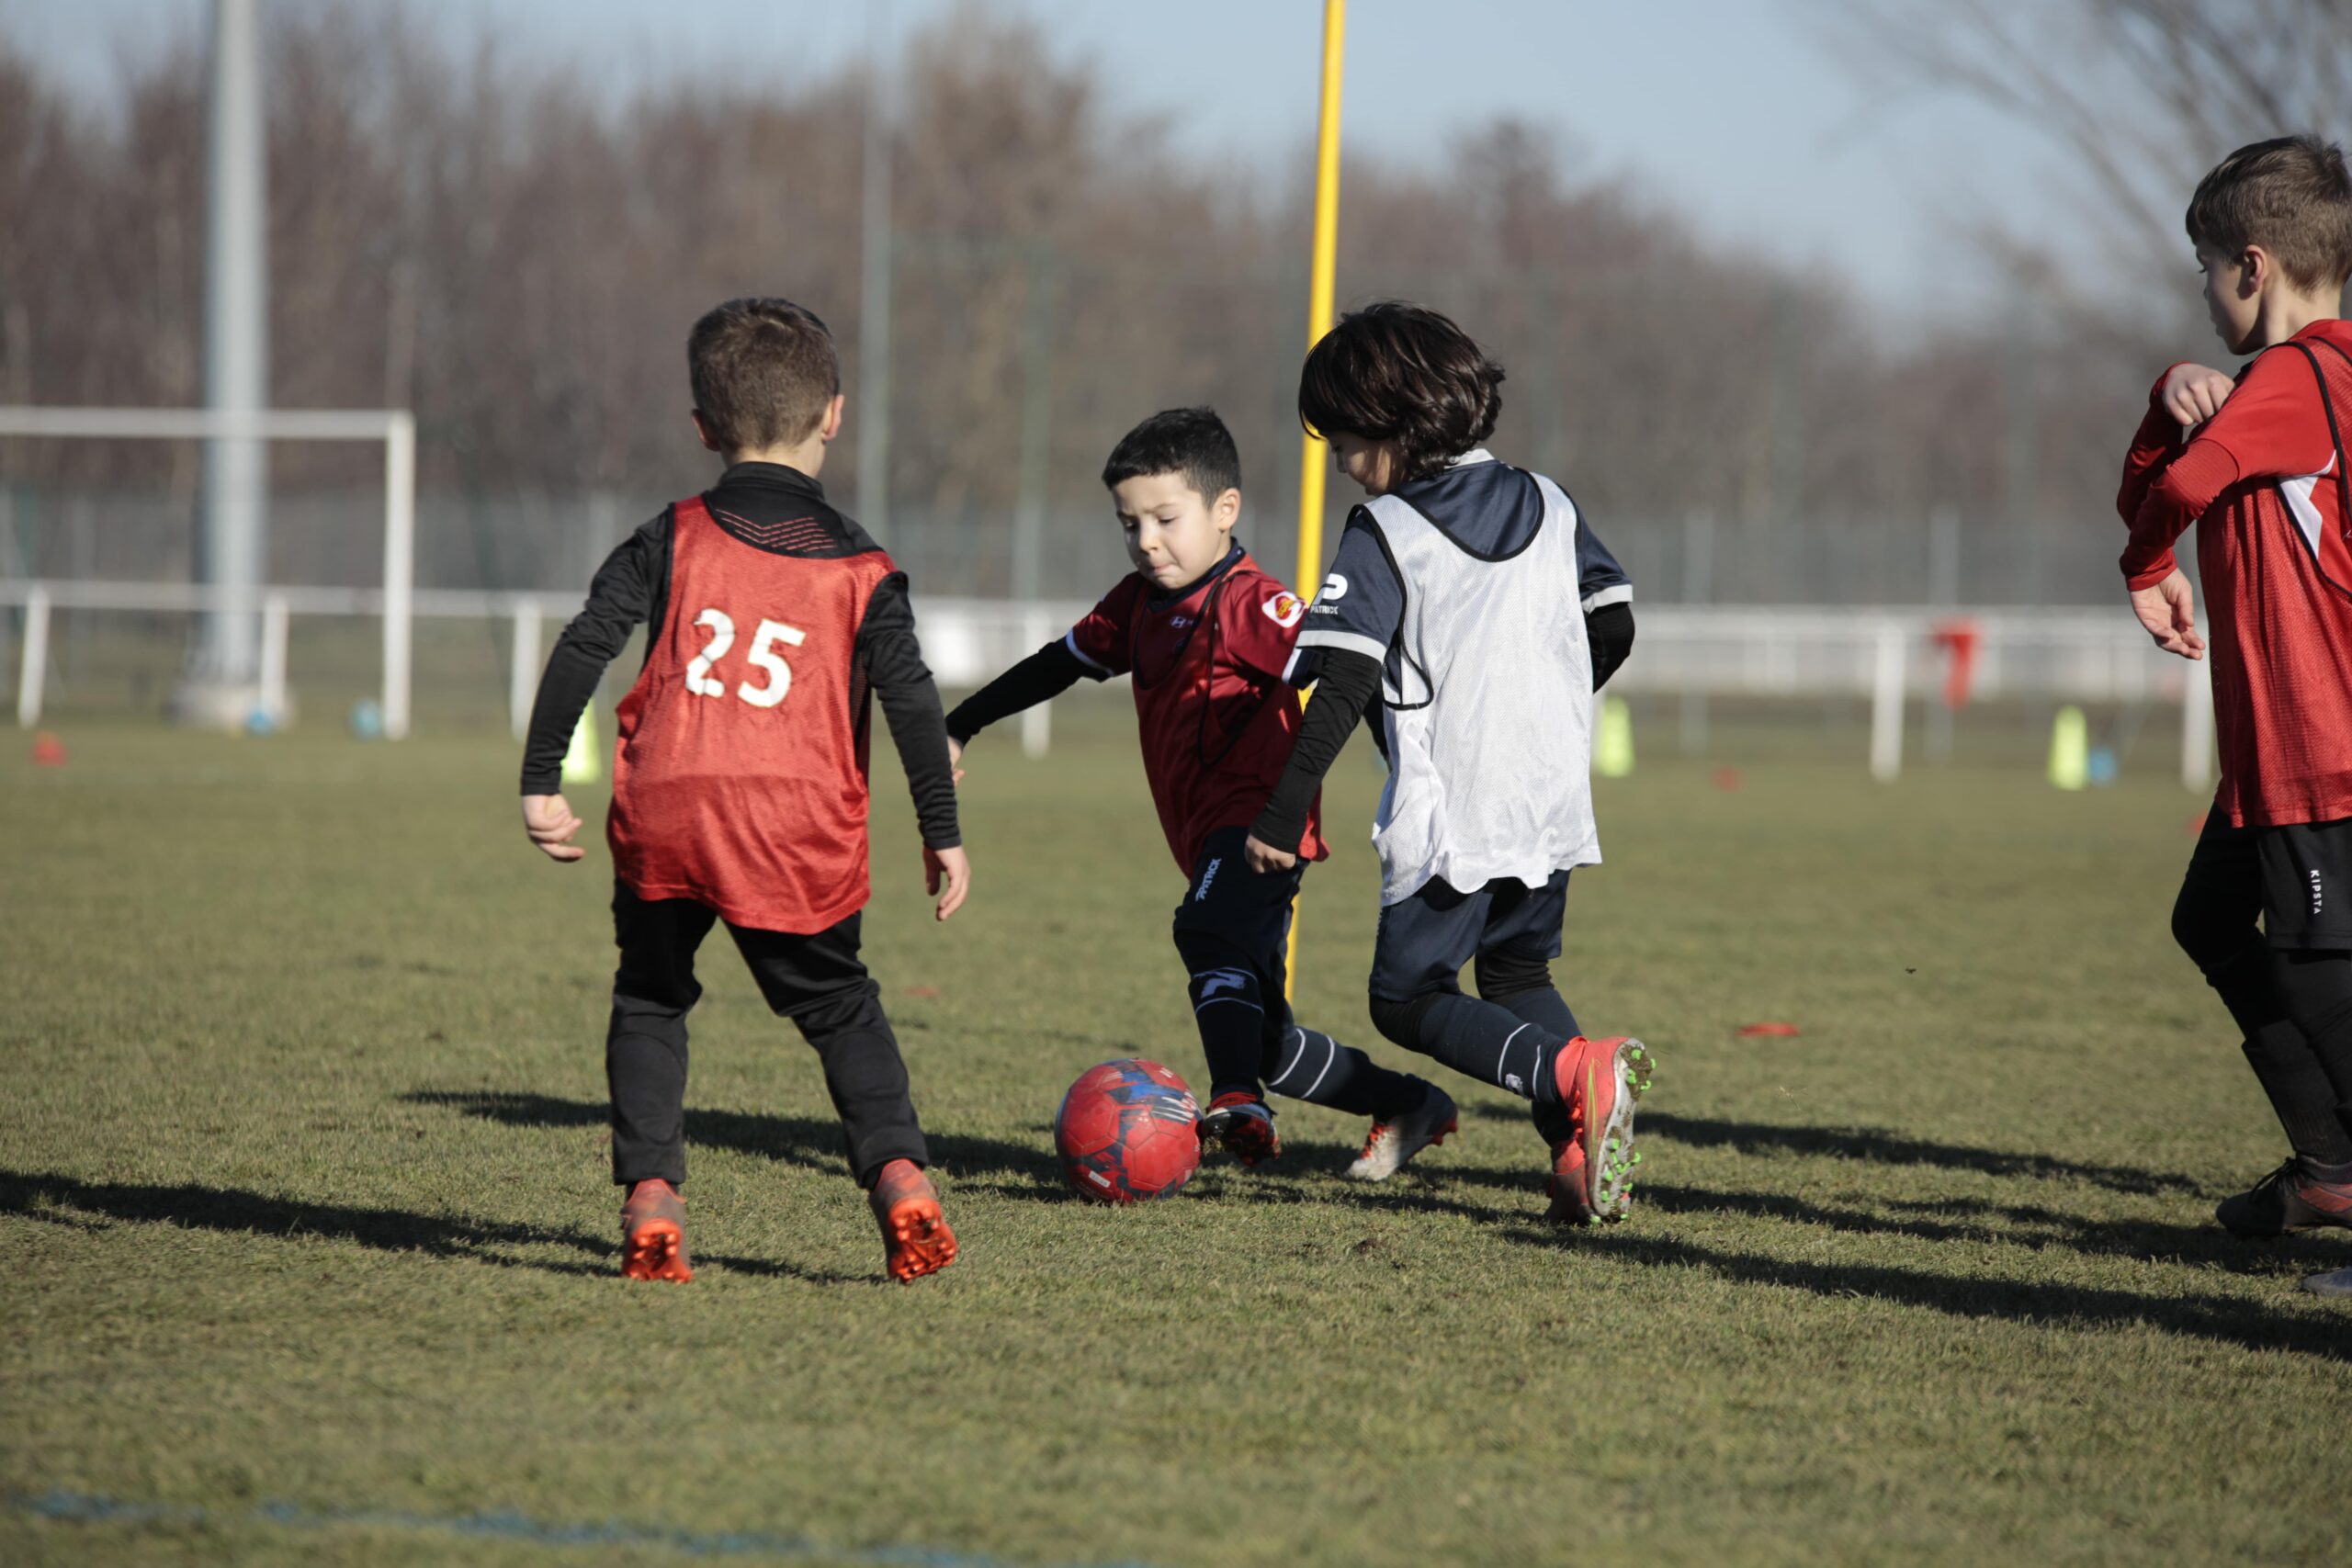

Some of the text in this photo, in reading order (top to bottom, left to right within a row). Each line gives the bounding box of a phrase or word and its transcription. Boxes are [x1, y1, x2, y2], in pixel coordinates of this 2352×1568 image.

[1310, 604, 1339, 615] PATRICK
[685, 607, 807, 708] 25
[1195, 858, 1222, 901] PATRICK
[2310, 869, 2322, 915] KIPSTA
